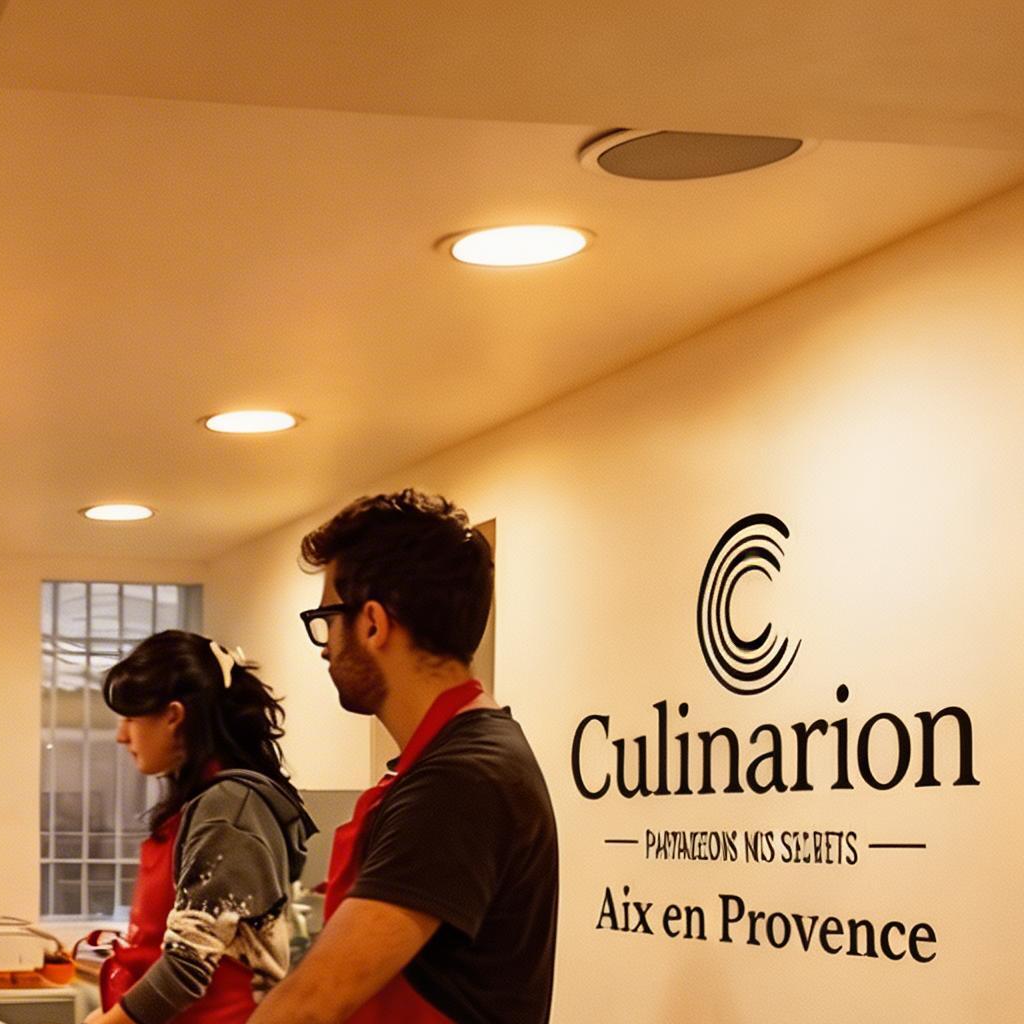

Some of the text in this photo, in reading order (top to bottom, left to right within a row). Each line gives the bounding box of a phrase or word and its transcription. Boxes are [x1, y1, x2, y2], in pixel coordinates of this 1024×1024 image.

[571, 683, 981, 801] Culinarion
[595, 885, 937, 964] Aix en Provence
